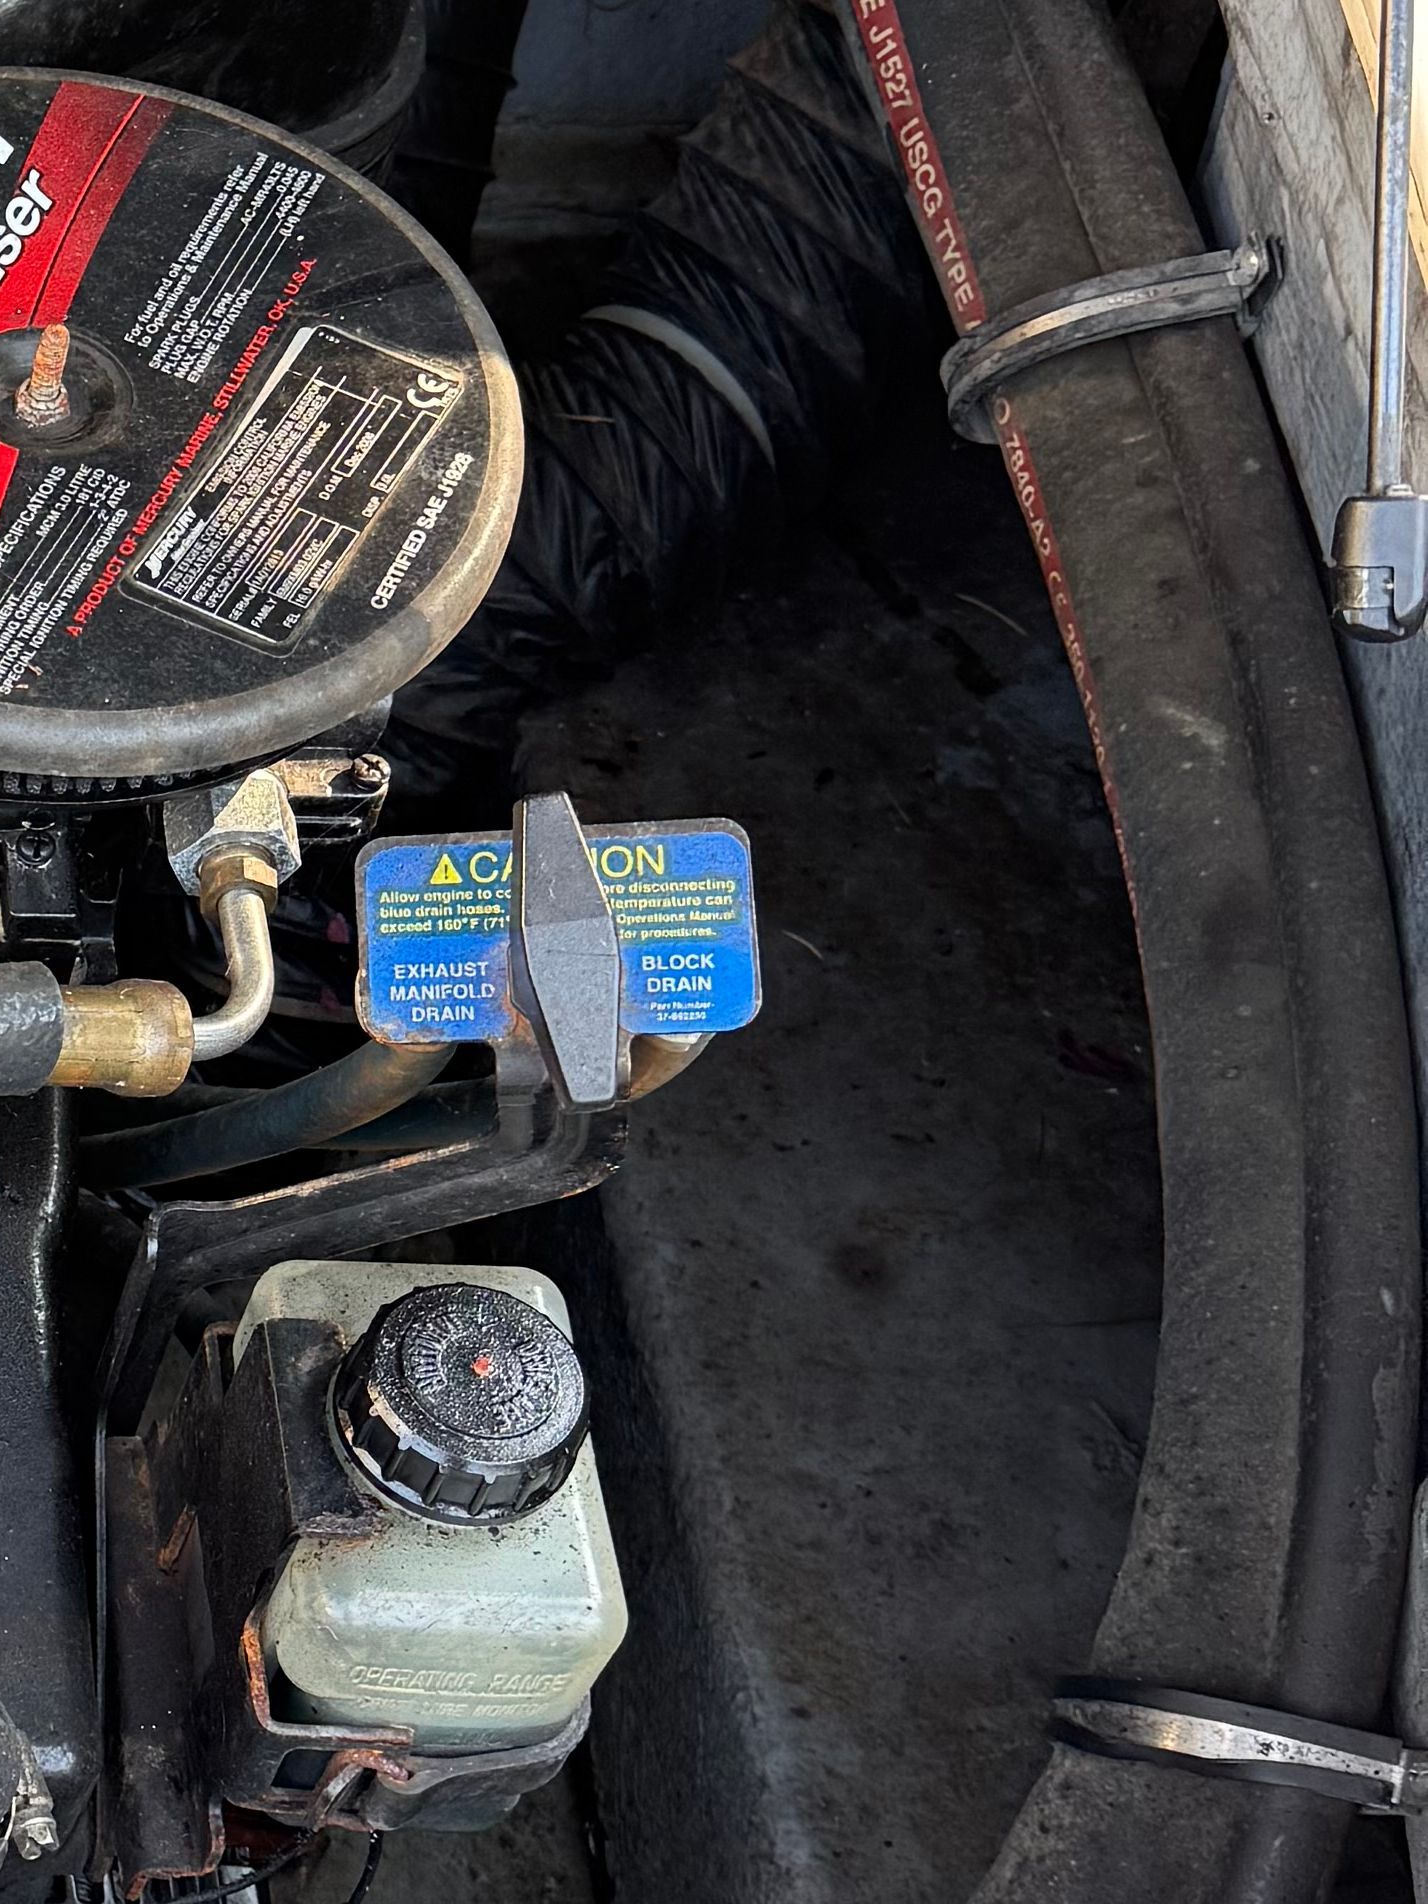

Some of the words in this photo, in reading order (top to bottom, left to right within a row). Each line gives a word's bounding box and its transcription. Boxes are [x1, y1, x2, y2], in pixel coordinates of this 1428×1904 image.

[869, 24, 914, 108] J1527
[899, 117, 944, 218] USCG
[935, 217, 977, 313] TYPE
[123, 322, 143, 343] For
[137, 299, 159, 323] fuel
[153, 277, 173, 301] and
[168, 262, 183, 278] oil
[177, 192, 228, 263] requirements
[223, 164, 244, 191] refer
[136, 335, 152, 347] to
[145, 273, 191, 334] Operations
[184, 263, 198, 273] &
[191, 193, 242, 262] Maintenance
[234, 151, 268, 192] Manual
[283, 258, 316, 294] U.S.A.
[186, 341, 219, 383] ENGINE
[212, 288, 252, 342] ROTATION
[291, 198, 310, 215] left
[302, 172, 325, 199] hand
[148, 332, 177, 369] SPARK
[171, 295, 201, 332] PLUGS
[173, 352, 200, 378] MAX.
[193, 318, 219, 349] W.O.T.
[211, 291, 235, 318] RPM
[267, 298, 296, 320] OK,
[160, 343, 186, 374] PLUG
[180, 319, 200, 343] GAP
[213, 324, 276, 409] STILLWATER,
[175, 412, 222, 467] MARINE,
[223, 429, 268, 483] INFORMATION
[233, 417, 267, 454] CONTROL
[35, 509, 60, 538] MCM
[64, 463, 92, 495] LITRE
[86, 468, 105, 487] CID
[132, 466, 182, 534] MERCURY
[162, 567, 183, 590] THIS
[178, 541, 206, 571] ENGINE
[200, 496, 238, 541] CONFORMS
[232, 484, 247, 496] TO
[255, 417, 294, 466] CALIFORNIA
[288, 378, 323, 420] EMISSION
[173, 539, 220, 597] REGULATIONS
[214, 521, 234, 540] FOR
[227, 495, 253, 525] SPARK
[294, 394, 326, 431] ENGINES
[191, 574, 214, 602] REFER
[210, 562, 225, 579] TO
[246, 496, 277, 528] MANUAL
[270, 476, 290, 496] FOR
[283, 420, 330, 478] MAINTENANCE
[205, 543, 257, 608] SPECIFICATIONS
[251, 525, 270, 545] AND
[265, 469, 312, 527] ADJUSTMENTS
[370, 529, 426, 608] CERTIFIED
[415, 495, 447, 529] SAE
[437, 452, 474, 497] J1928
[14, 580, 46, 619] ORDER
[89, 473, 119, 508] 1-3-4-2
[16, 601, 49, 638] TIMING
[106, 479, 130, 508] ATDC
[118, 533, 137, 555] OF
[144, 503, 196, 578] MERCURY
[28, 599, 67, 648] IGNITION
[60, 562, 92, 598] TIMING
[86, 508, 127, 561] REQUIRED
[74, 555, 124, 623] PRODUCT
[66, 625, 83, 637] A
[250, 597, 277, 628] FAMILY
[282, 613, 301, 628] FEL
[380, 890, 420, 903] Allow
[423, 890, 473, 904] engine
[477, 889, 492, 900] to
[628, 879, 736, 894] disconnecting
[380, 905, 411, 917] blue
[414, 903, 454, 917] drain
[457, 902, 505, 917] hoses.
[705, 895, 733, 907] can
[380, 920, 431, 934] exceed
[616, 912, 685, 925] Operations
[687, 910, 736, 922] Manual
[620, 928, 638, 939] for
[394, 961, 489, 980] EXHAUST
[641, 953, 715, 972] BLOCK
[646, 976, 712, 994] DRAIN
[390, 982, 496, 1002] MANIFOLD
[411, 1004, 475, 1024] DRAIN
[349, 1666, 477, 1689] OPERATING
[488, 1673, 571, 1692] RANGE
